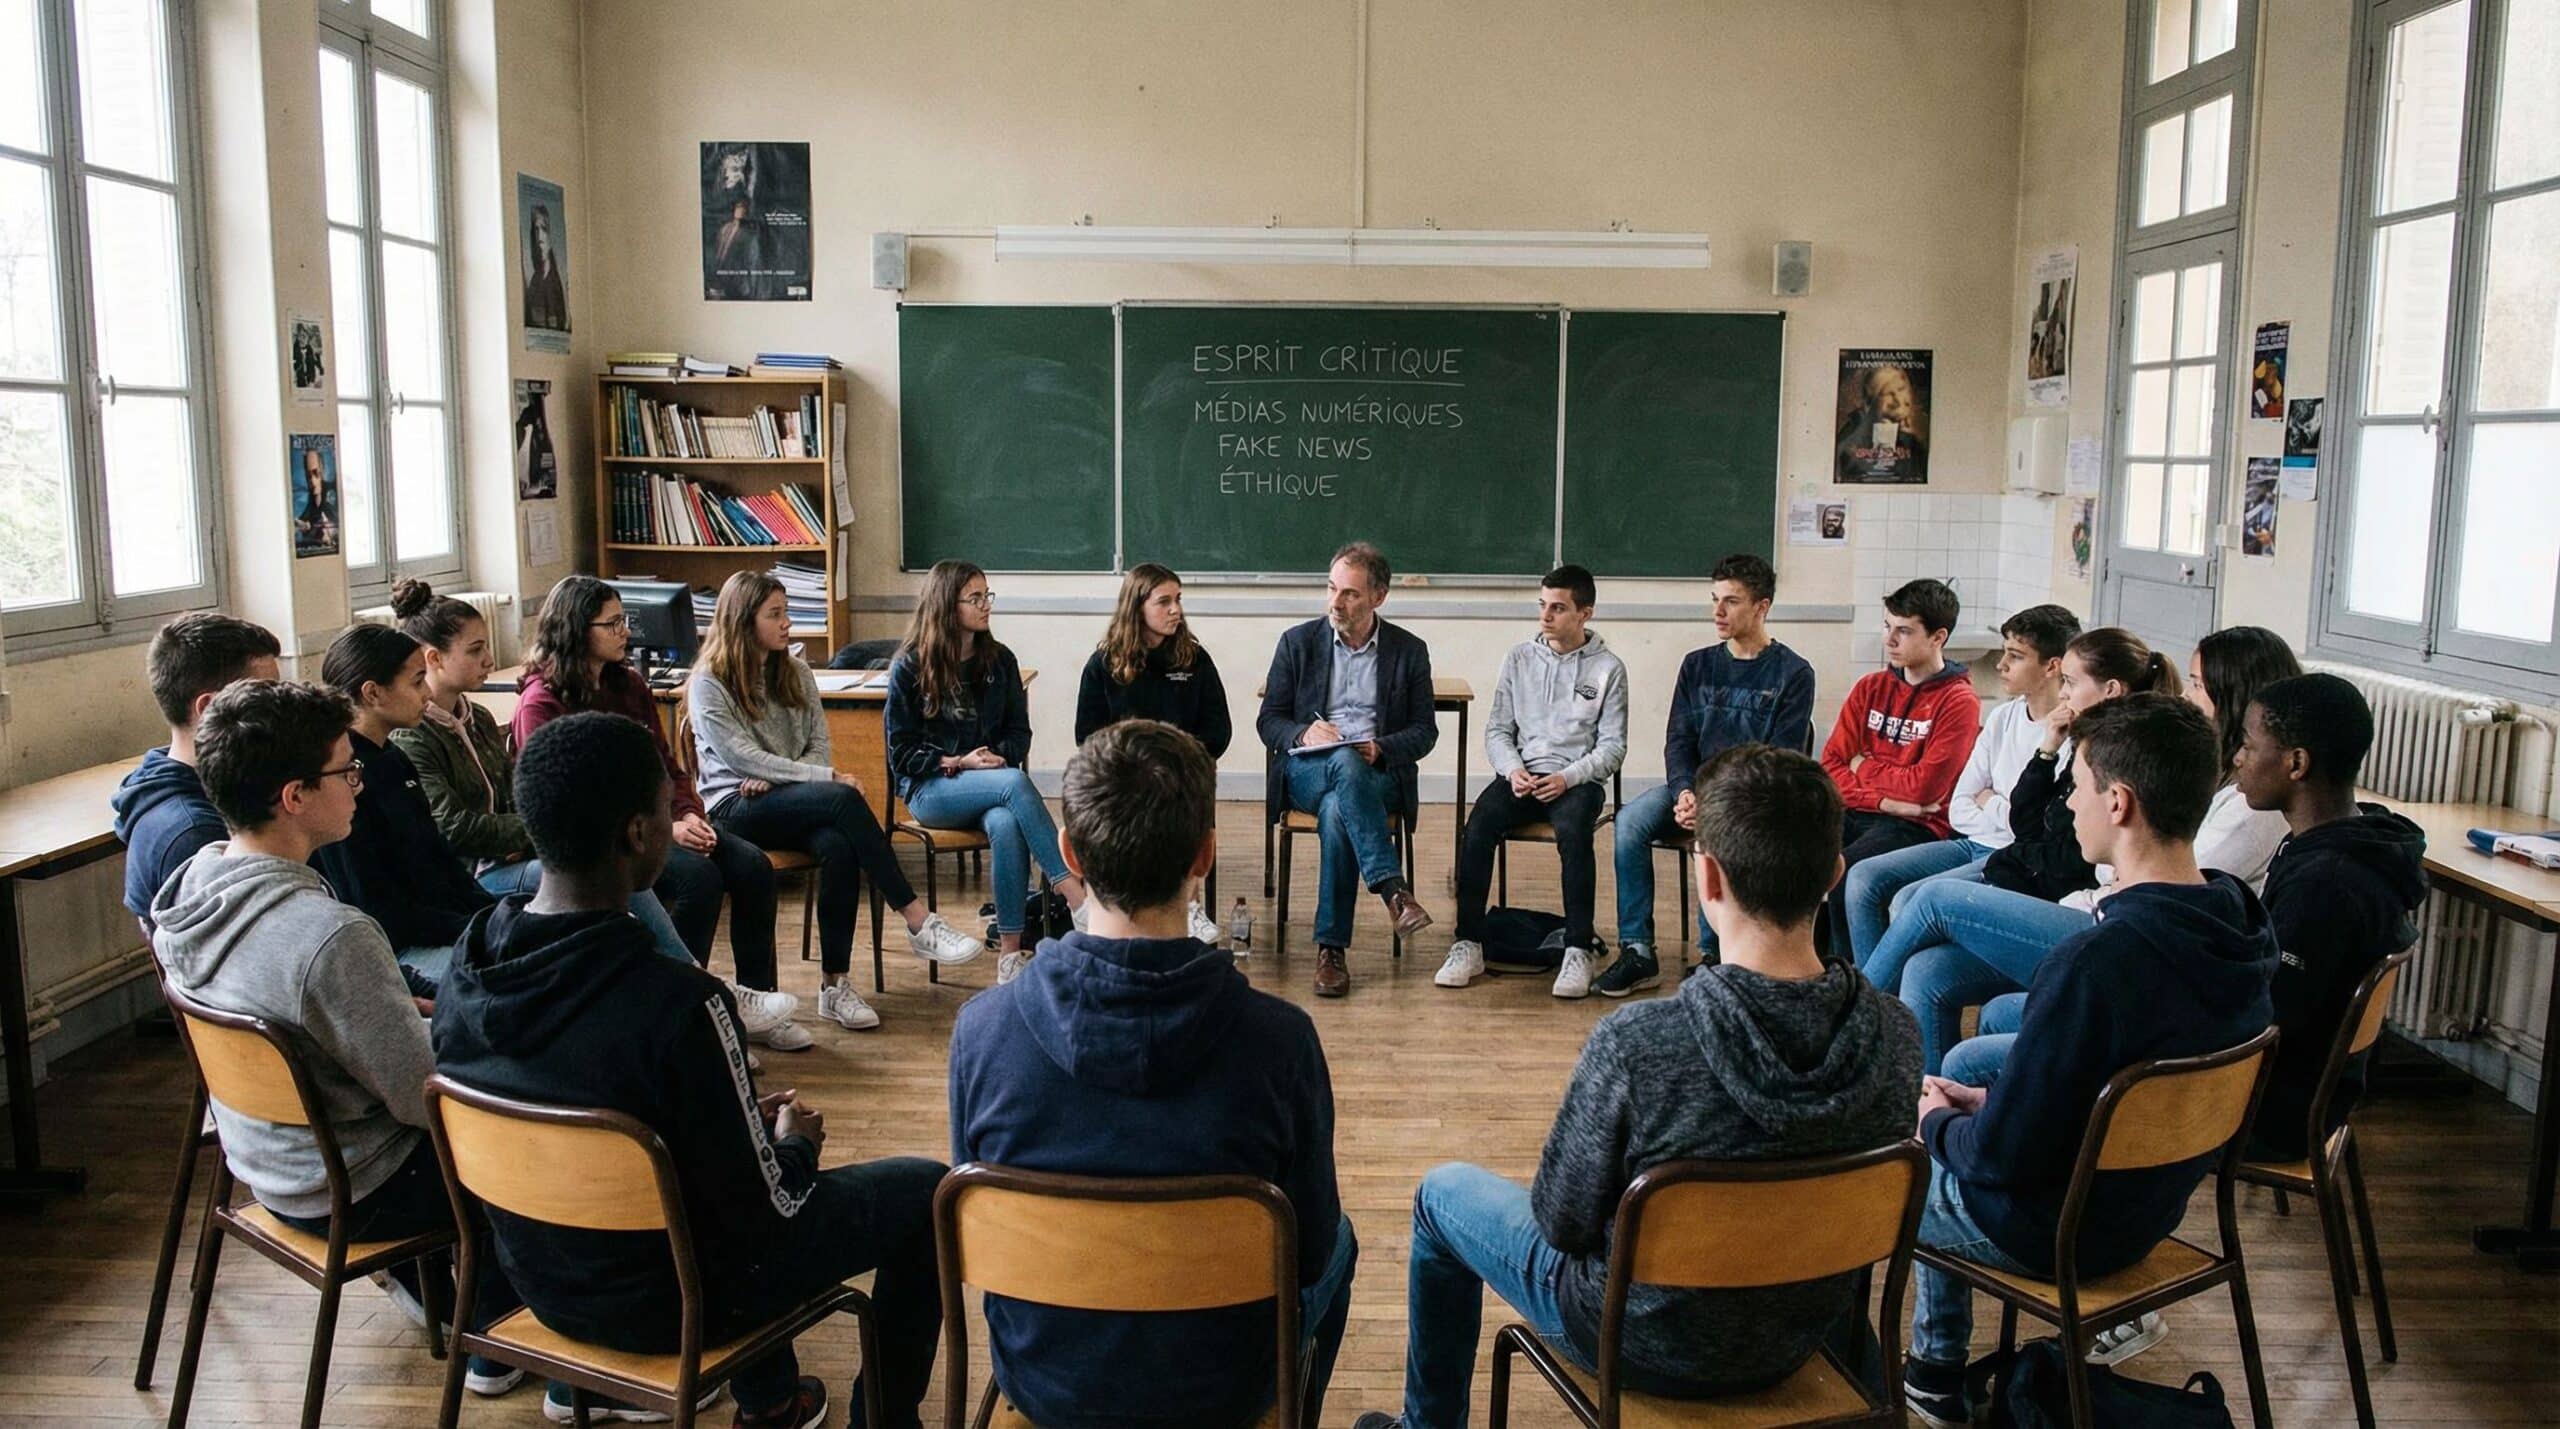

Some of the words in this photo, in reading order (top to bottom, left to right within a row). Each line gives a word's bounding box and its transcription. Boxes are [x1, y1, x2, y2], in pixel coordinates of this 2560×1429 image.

[1193, 339, 1303, 373] ESPRIT
[1319, 340, 1464, 379] CRITIQUE
[1195, 391, 1287, 424] MÉDIAS
[1301, 393, 1464, 429] NUMÉRIQUES
[1219, 434, 1282, 458] FAKE
[1298, 437, 1372, 461] NEWS
[1220, 464, 1339, 499] ÉTHIQUE
